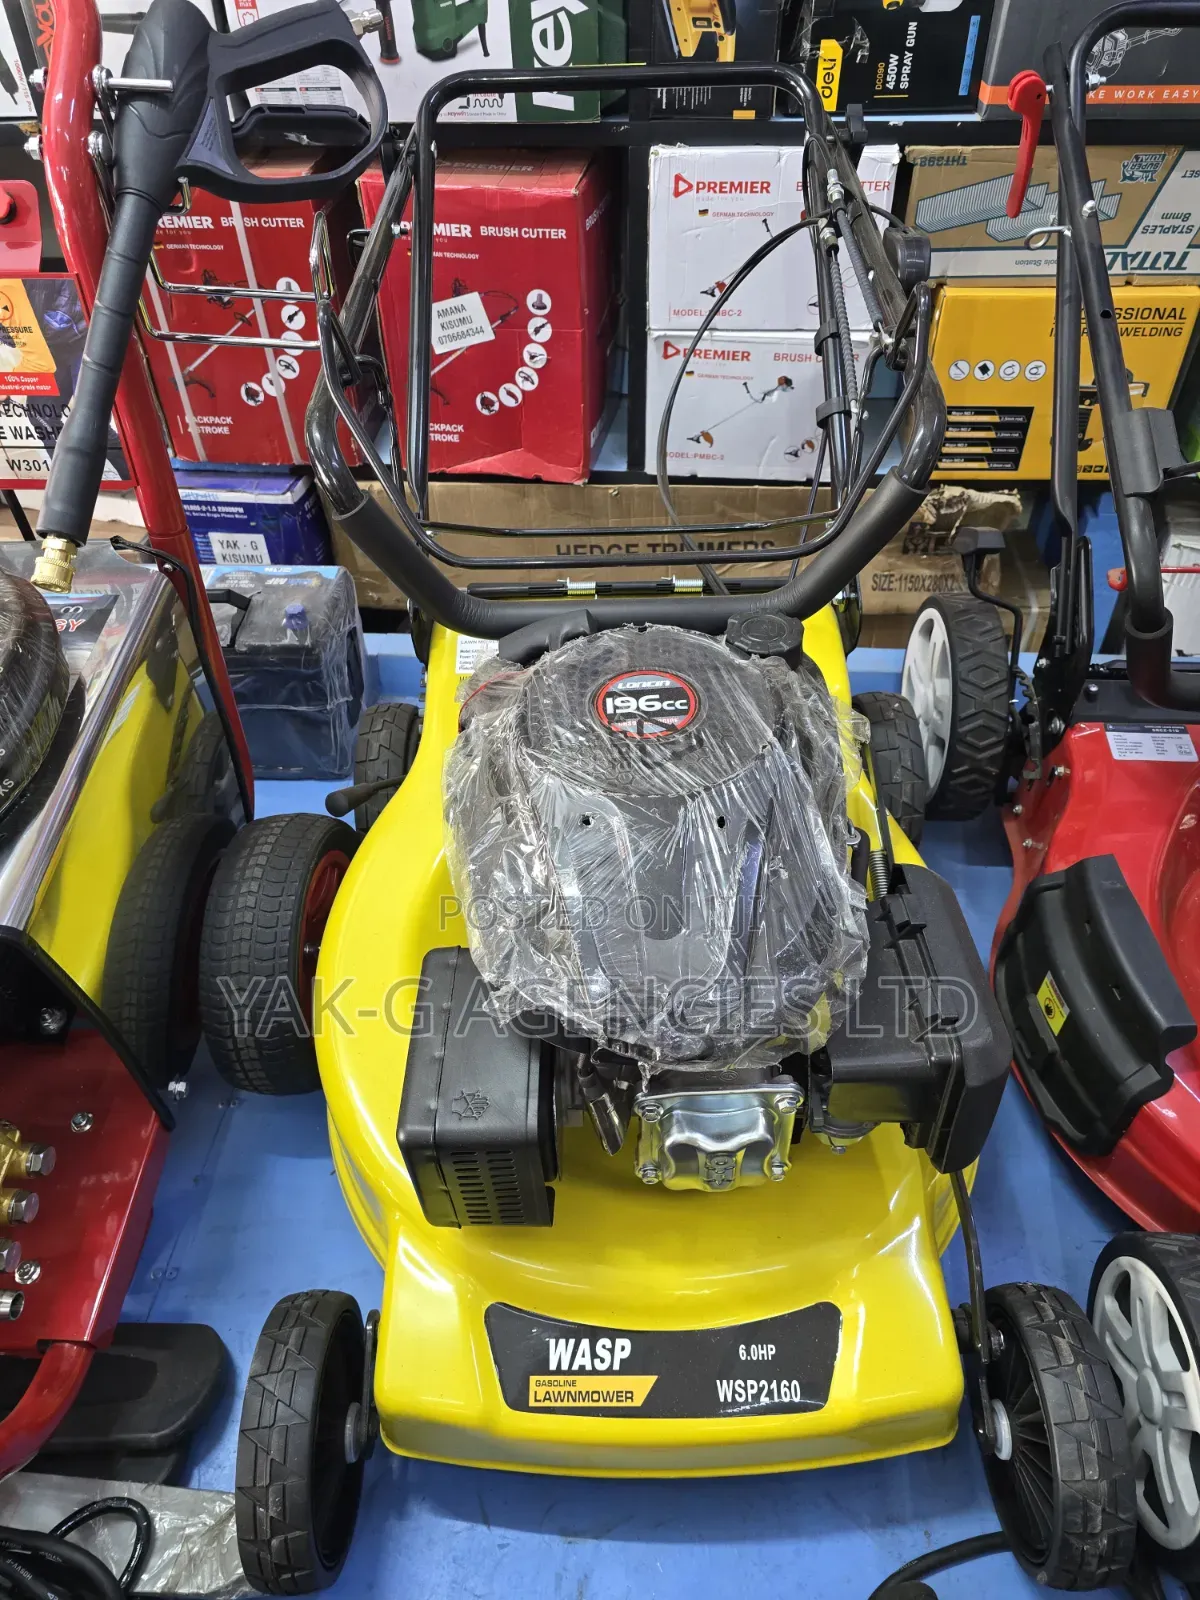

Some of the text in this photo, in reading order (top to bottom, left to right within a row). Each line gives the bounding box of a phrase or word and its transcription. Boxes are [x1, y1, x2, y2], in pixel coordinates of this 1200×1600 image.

[900, 21, 918, 89] SPRAY GUN
[822, 58, 837, 99] deli
[875, 62, 885, 91] DC090
[886, 54, 900, 90] 450W
[1114, 90, 1155, 99] WORK
[1163, 90, 1200, 99] EASY
[1129, 162, 1161, 170] SUPER
[695, 180, 771, 194] PREMIER
[221, 217, 258, 228] BRSH
[261, 217, 305, 228] CUTTER
[1161, 212, 1191, 222] 8mm
[400, 221, 567, 239] PMIER BRUSH CUTTER
[1141, 224, 1195, 234] STAPLES
[443, 252, 480, 260] TECHNOLOGY
[1014, 259, 1043, 267] Station
[1107, 250, 1190, 271] TOTAL
[437, 303, 467, 320] AMANA
[672, 309, 743, 317] MODEL:MBC-2
[0, 326, 33, 334] RESSURE
[440, 315, 473, 332] KISUMU
[1120, 327, 1184, 337] WELDING
[683, 347, 751, 362] PREMIER
[773, 352, 812, 363] BRUSH
[0, 403, 71, 417] ECHNOLO
[665, 452, 725, 460] ODEL:PMBC-2
[218, 539, 240, 550] YAK
[250, 540, 259, 550] G
[221, 553, 264, 564] KISUMU
[871, 572, 962, 592] SIZE:1150X280X2
[605, 694, 689, 715] 196cc
[548, 1337, 632, 1371] WASP
[738, 1344, 776, 1361] 6.0HP
[535, 1379, 577, 1388] GASOLINE
[534, 1390, 634, 1403] LAWNMOWER
[716, 1379, 801, 1403] WSP2160
